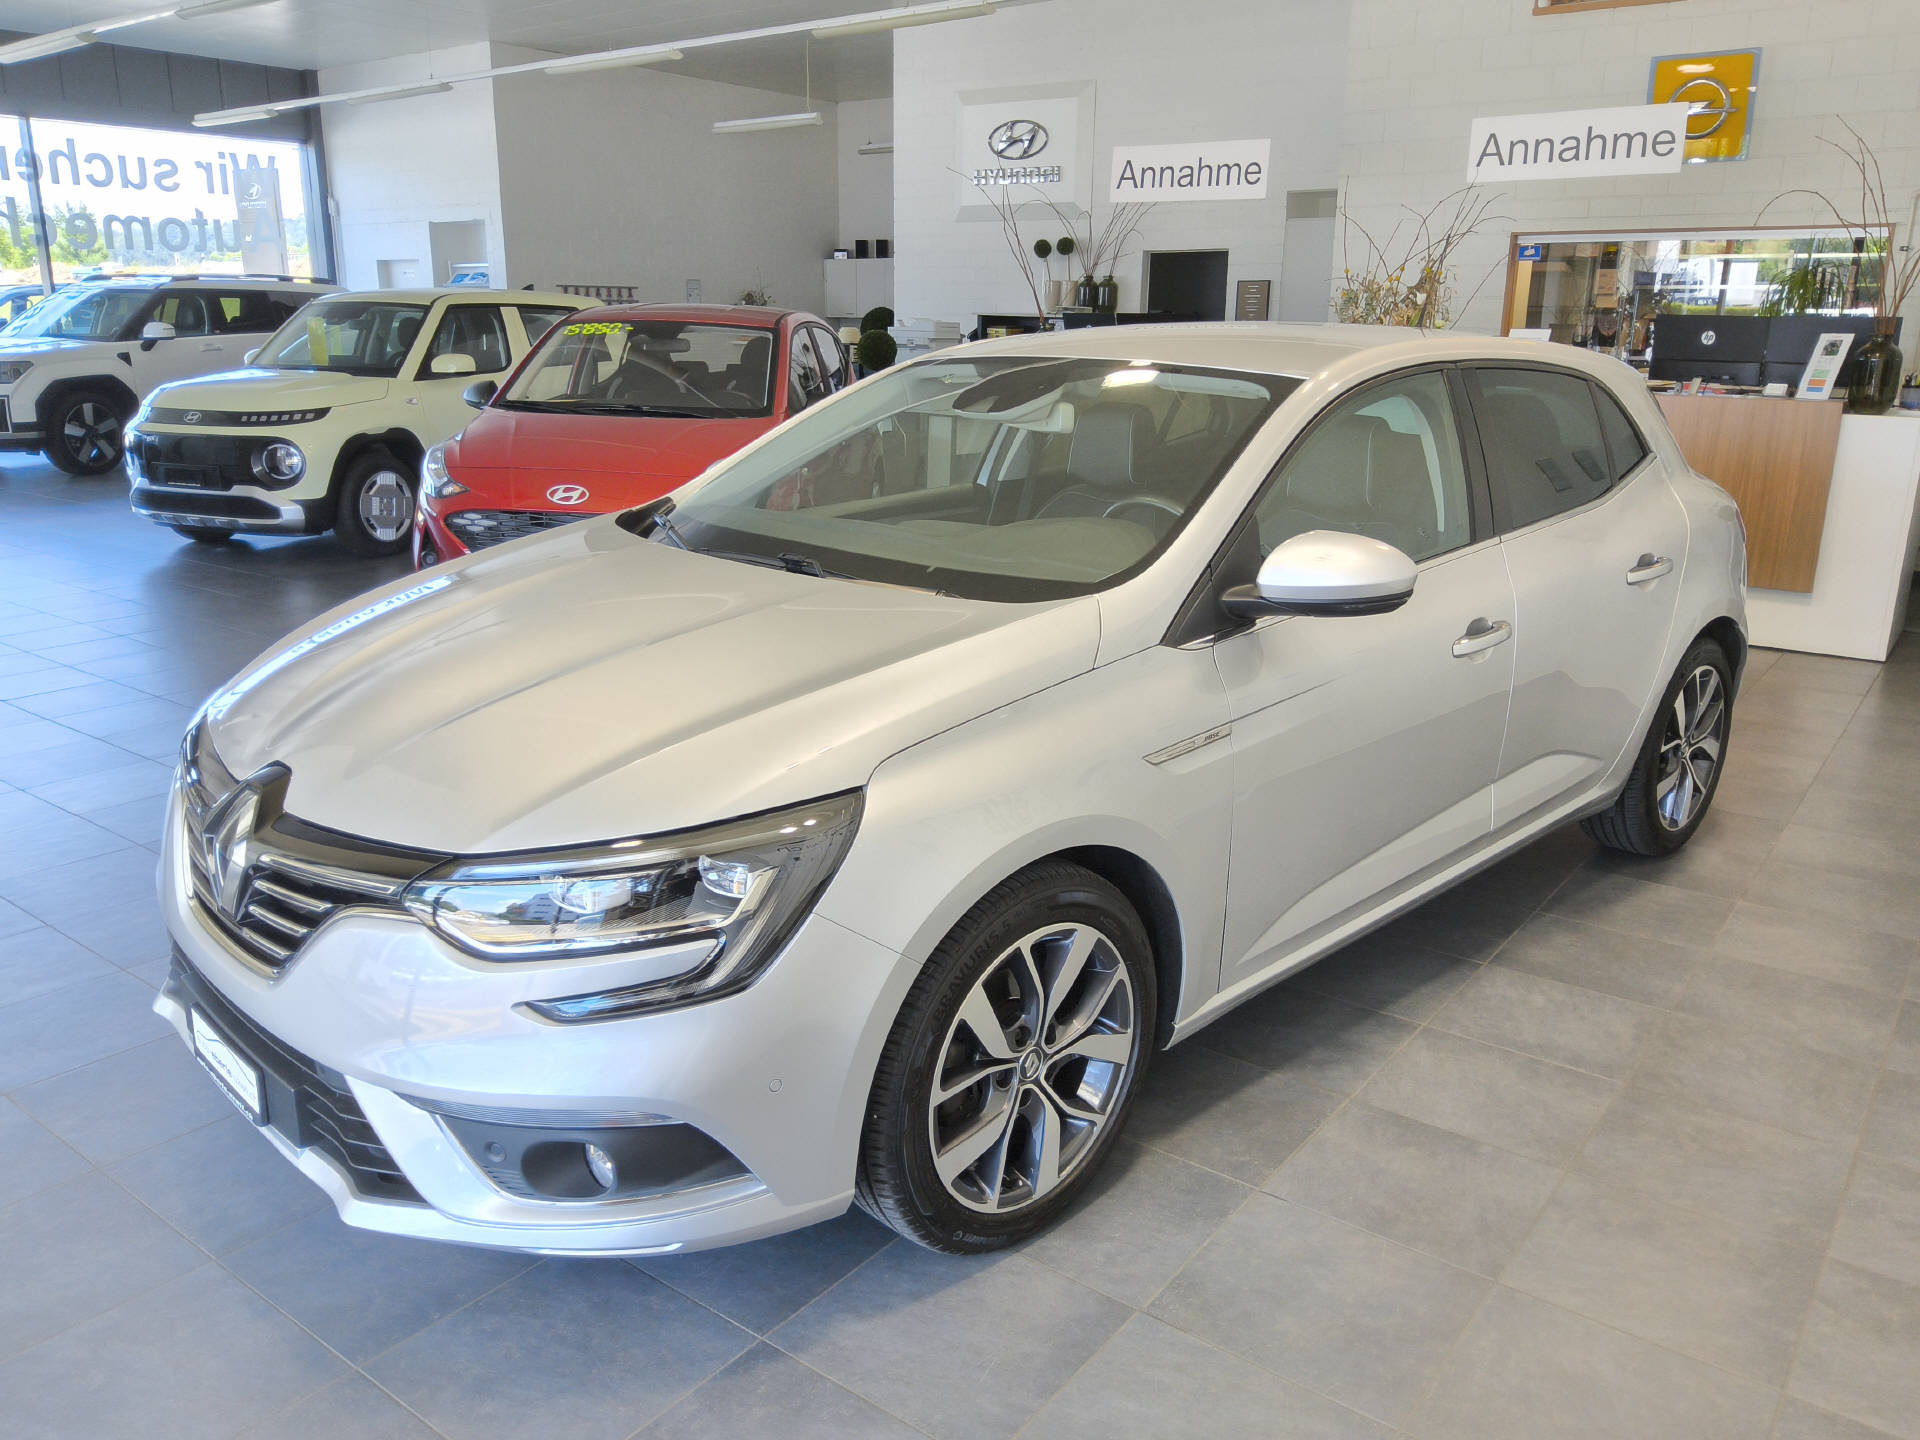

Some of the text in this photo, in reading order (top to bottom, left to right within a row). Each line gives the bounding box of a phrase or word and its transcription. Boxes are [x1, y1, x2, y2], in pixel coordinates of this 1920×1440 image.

[1476, 126, 1676, 167] Annahme
[973, 166, 1061, 186] HYUNDAI
[1116, 157, 1262, 189] Annahme
[1701, 330, 1716, 345] hp
